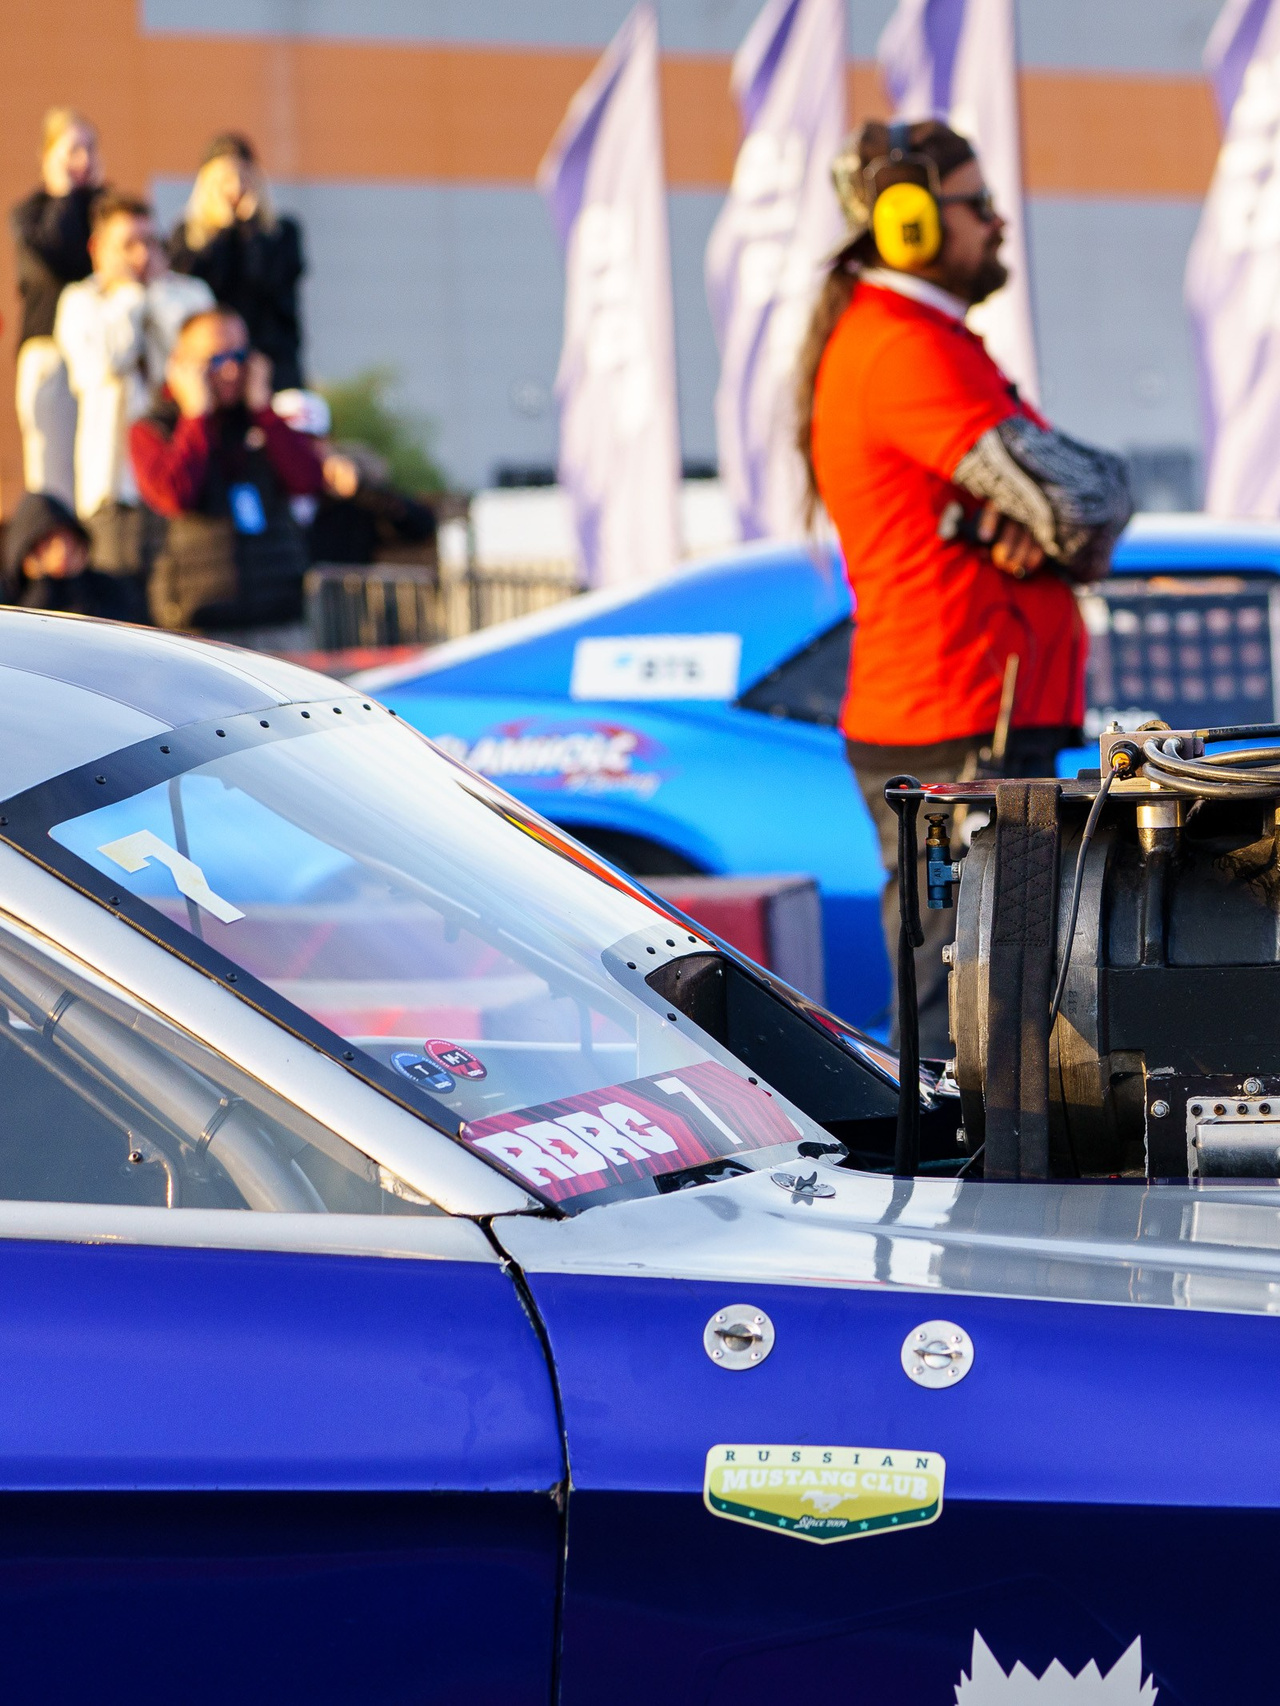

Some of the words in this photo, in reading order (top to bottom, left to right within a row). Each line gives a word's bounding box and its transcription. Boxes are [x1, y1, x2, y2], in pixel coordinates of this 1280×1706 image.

[97, 829, 246, 924] 7
[473, 1101, 679, 1187] RDRC
[721, 1468, 856, 1494] MUSTANG
[860, 1472, 929, 1501] CLUB
[725, 1450, 929, 1469] RUSSIAN
